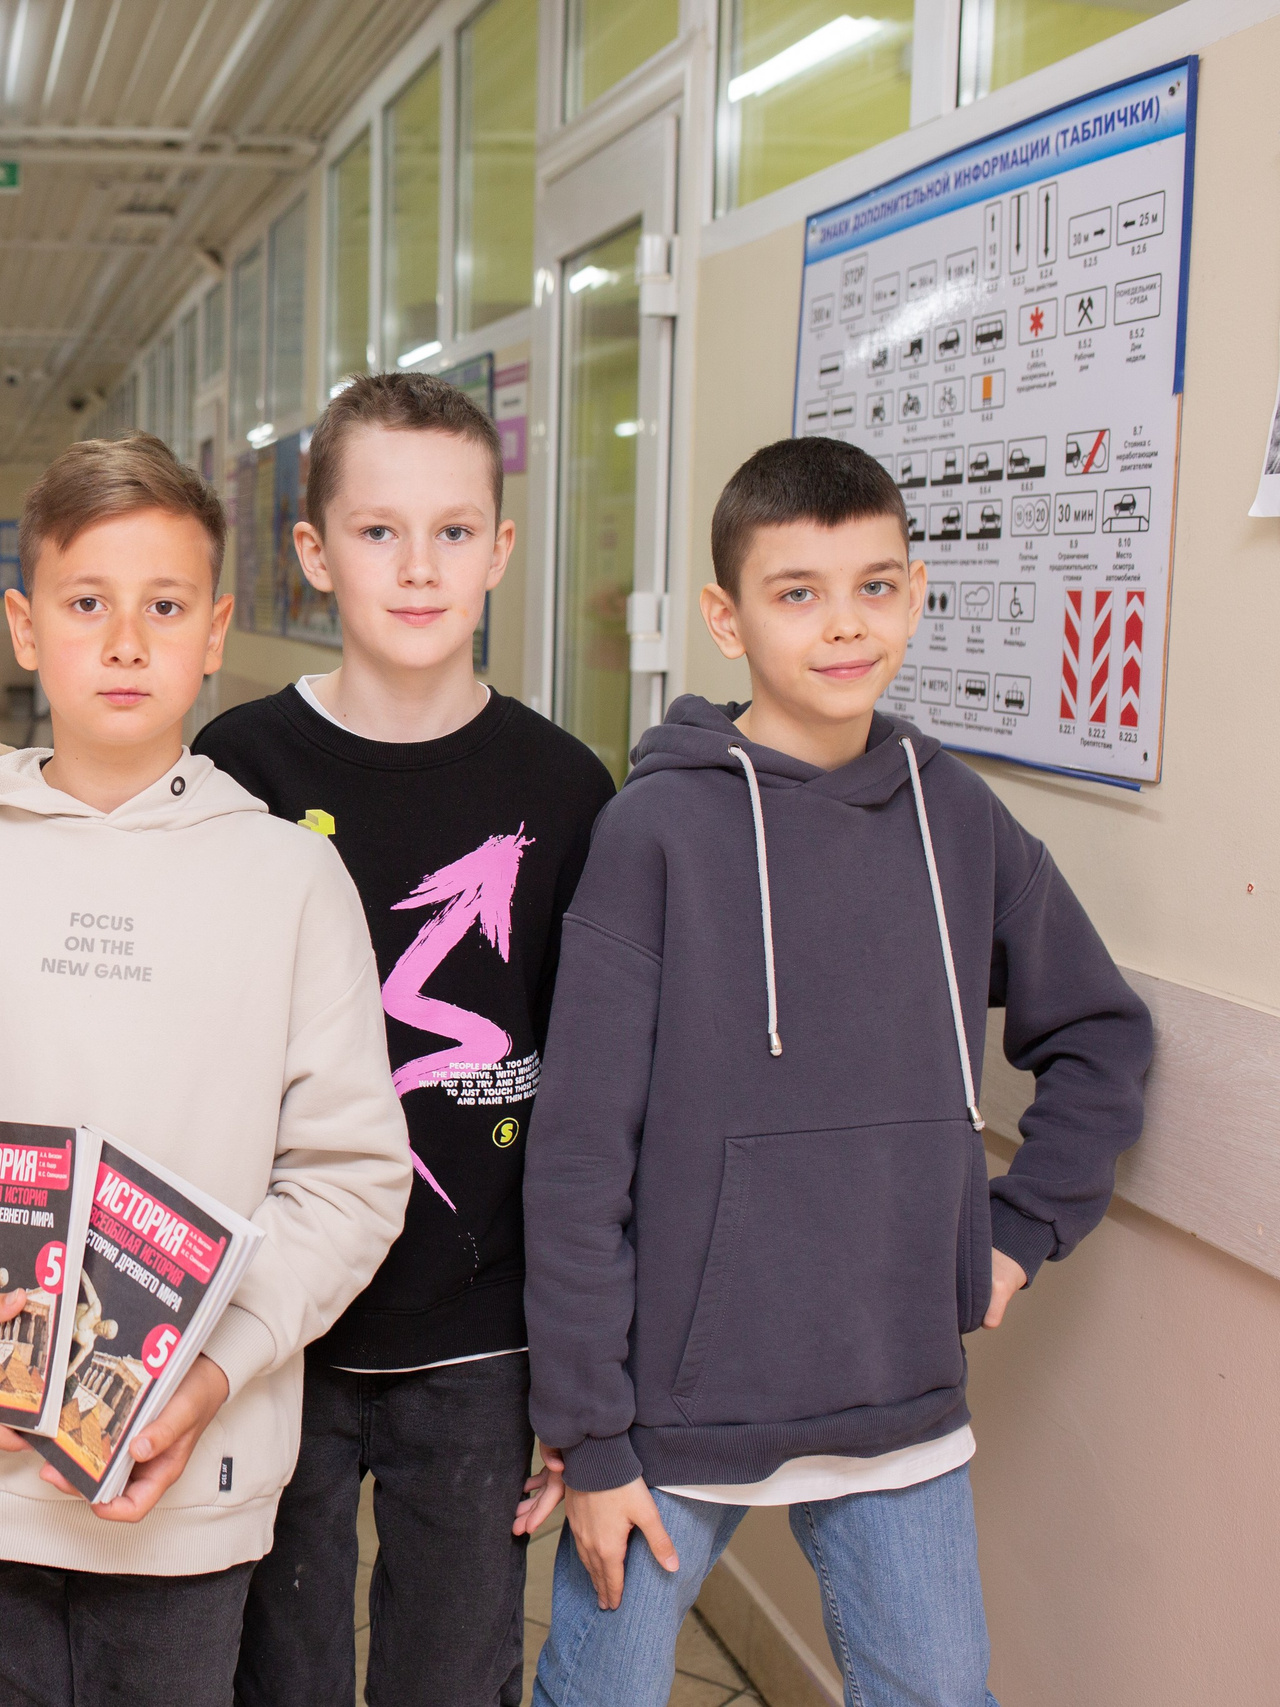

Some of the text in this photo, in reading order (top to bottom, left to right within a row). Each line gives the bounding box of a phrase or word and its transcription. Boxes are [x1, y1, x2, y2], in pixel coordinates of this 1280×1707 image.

[954, 135, 1051, 191] ИНФОРМАЦИИ
[1055, 95, 1161, 157] (ТАБЛИЧКИ)
[1139, 213, 1150, 226] 25
[1073, 232, 1082, 246] 30
[1131, 243, 1147, 256] 8.2.6
[1129, 327, 1145, 340] 8.5.2
[1133, 426, 1143, 436] 8.7
[1036, 508, 1045, 519] 20
[1058, 504, 1094, 523] 30 мин
[1059, 724, 1075, 735] 8.22.1
[1088, 727, 1106, 739] 8.22.2
[1119, 731, 1138, 743] 8.22.3
[69, 912, 135, 932] FOCUS
[64, 936, 135, 956] ON THE
[40, 957, 153, 982] NEW GAME
[449, 1059, 522, 1071] PEOPLE DEAL TOO
[450, 1071, 493, 1080] NEGATIVE,
[496, 1069, 517, 1079] WITH
[419, 1080, 439, 1088] WHY
[440, 1080, 459, 1088] NOT
[461, 1080, 473, 1088] TO
[476, 1080, 493, 1088] TRY
[495, 1078, 514, 1087] AND
[446, 1088, 458, 1097] TO
[460, 1088, 480, 1097] JUST
[483, 1087, 513, 1096] TOUCH
[457, 1097, 476, 1106] AND
[478, 1096, 503, 1105] MAKE
[500, 1122, 514, 1143] S
[4, 1186, 48, 1208] ИСТОРИЯ
[31, 1210, 55, 1229] МИРА
[96, 1171, 189, 1257] ИСТОРИЯ
[44, 1246, 63, 1288] 5
[86, 1228, 119, 1263] СТОРИЯ
[114, 1252, 160, 1294] ДРЕВНЕГО
[155, 1282, 184, 1313] МИРА
[139, 1243, 186, 1288] ИСТОРИЯ
[146, 1328, 177, 1369] 5
